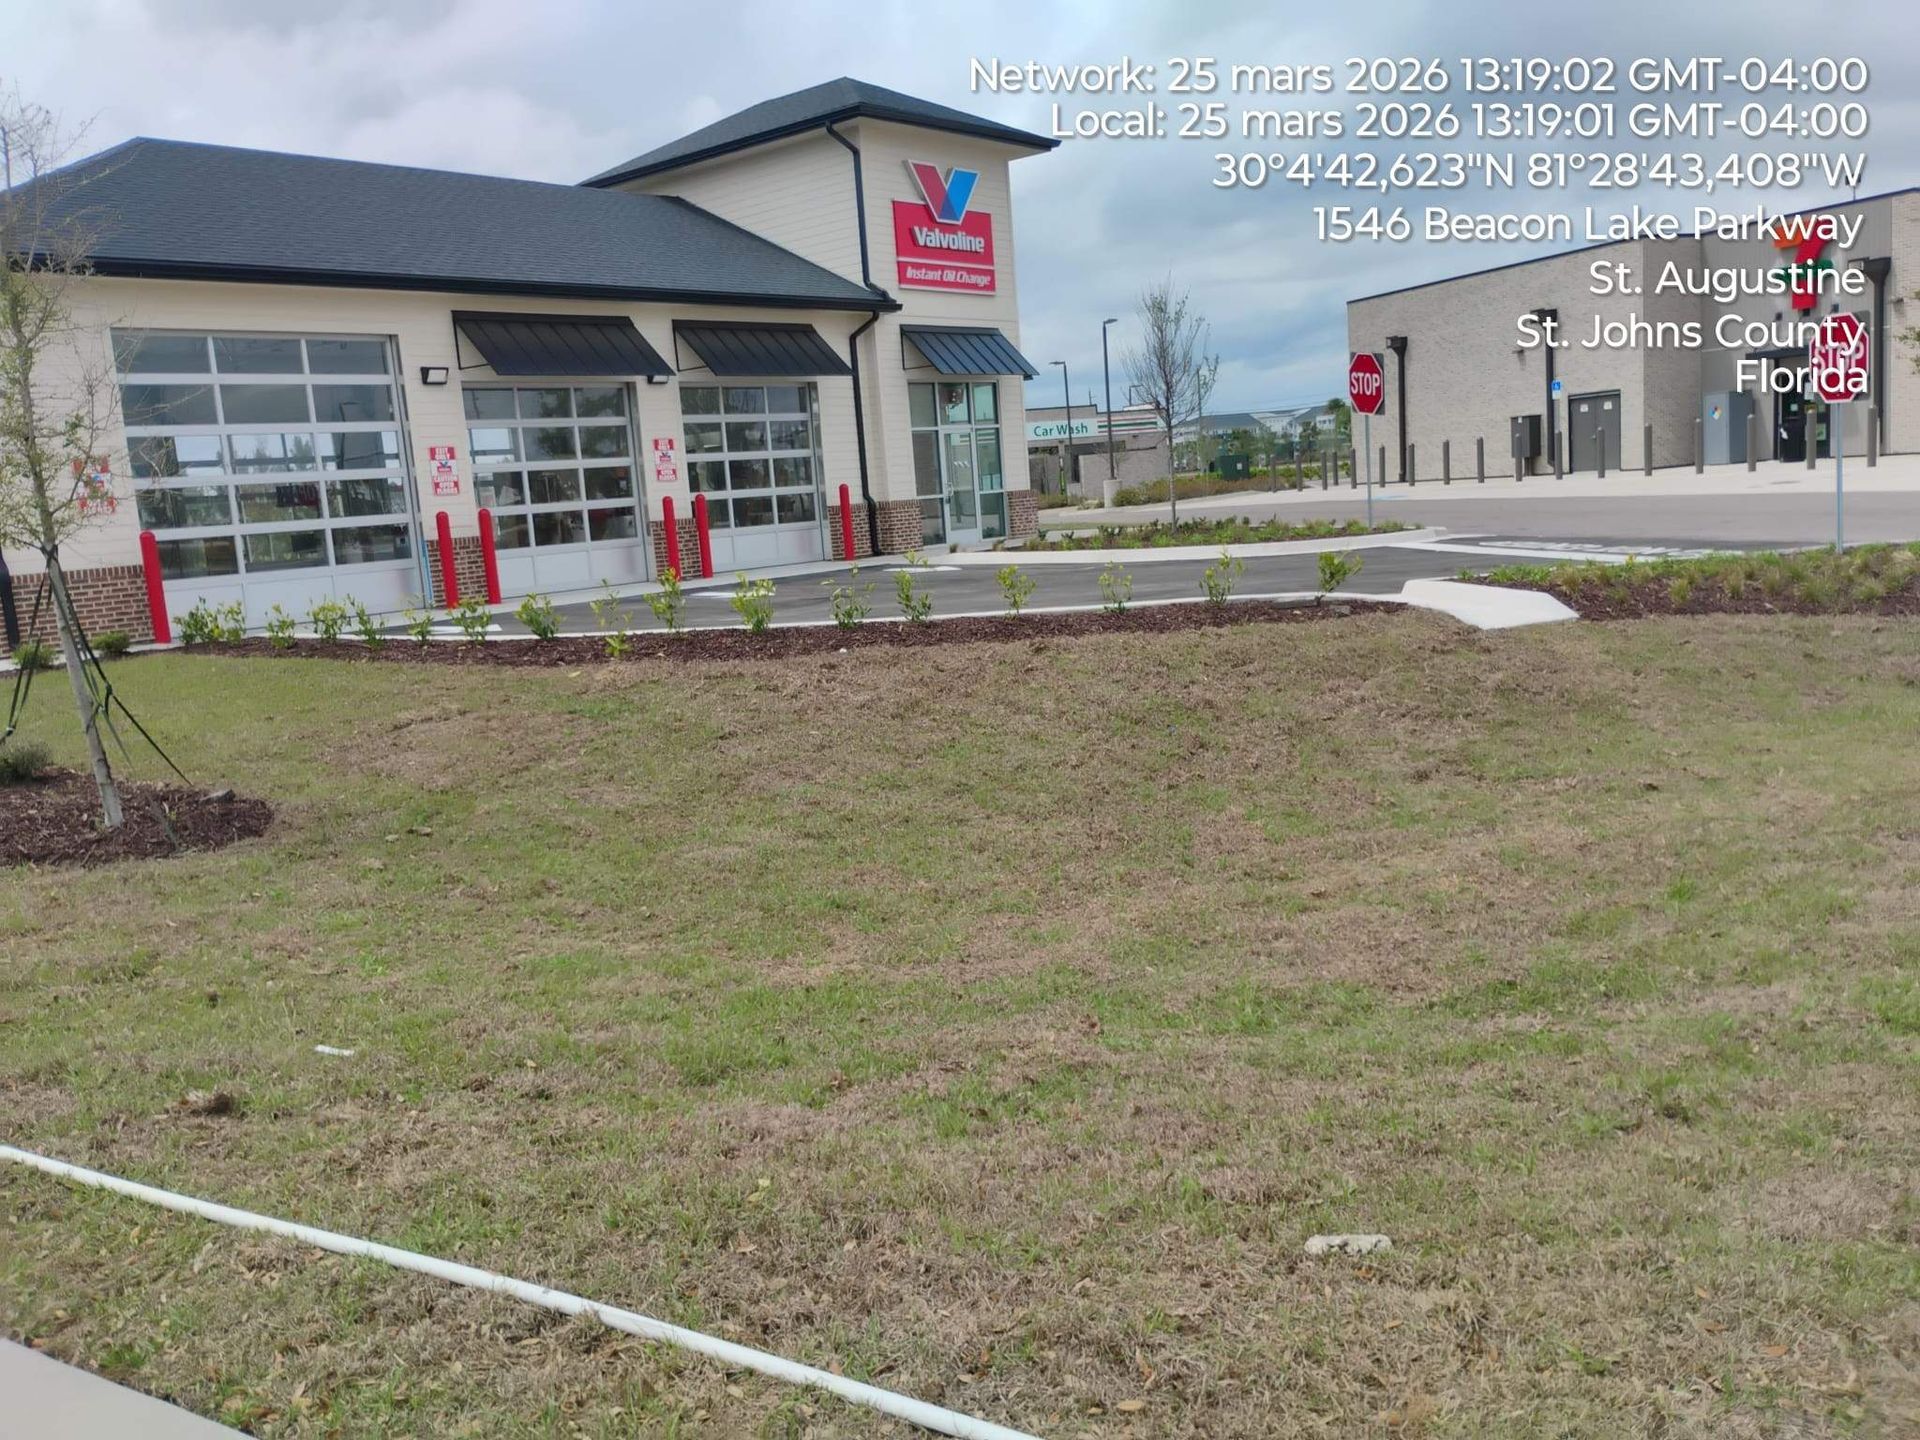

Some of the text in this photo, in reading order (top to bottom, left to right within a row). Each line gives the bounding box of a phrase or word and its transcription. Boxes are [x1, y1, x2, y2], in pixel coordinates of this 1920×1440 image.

[913, 226, 985, 252] Valvoline
[906, 266, 990, 287] Instant Oil Change
[1350, 371, 1380, 396] STOP
[1033, 425, 1053, 437] Car
